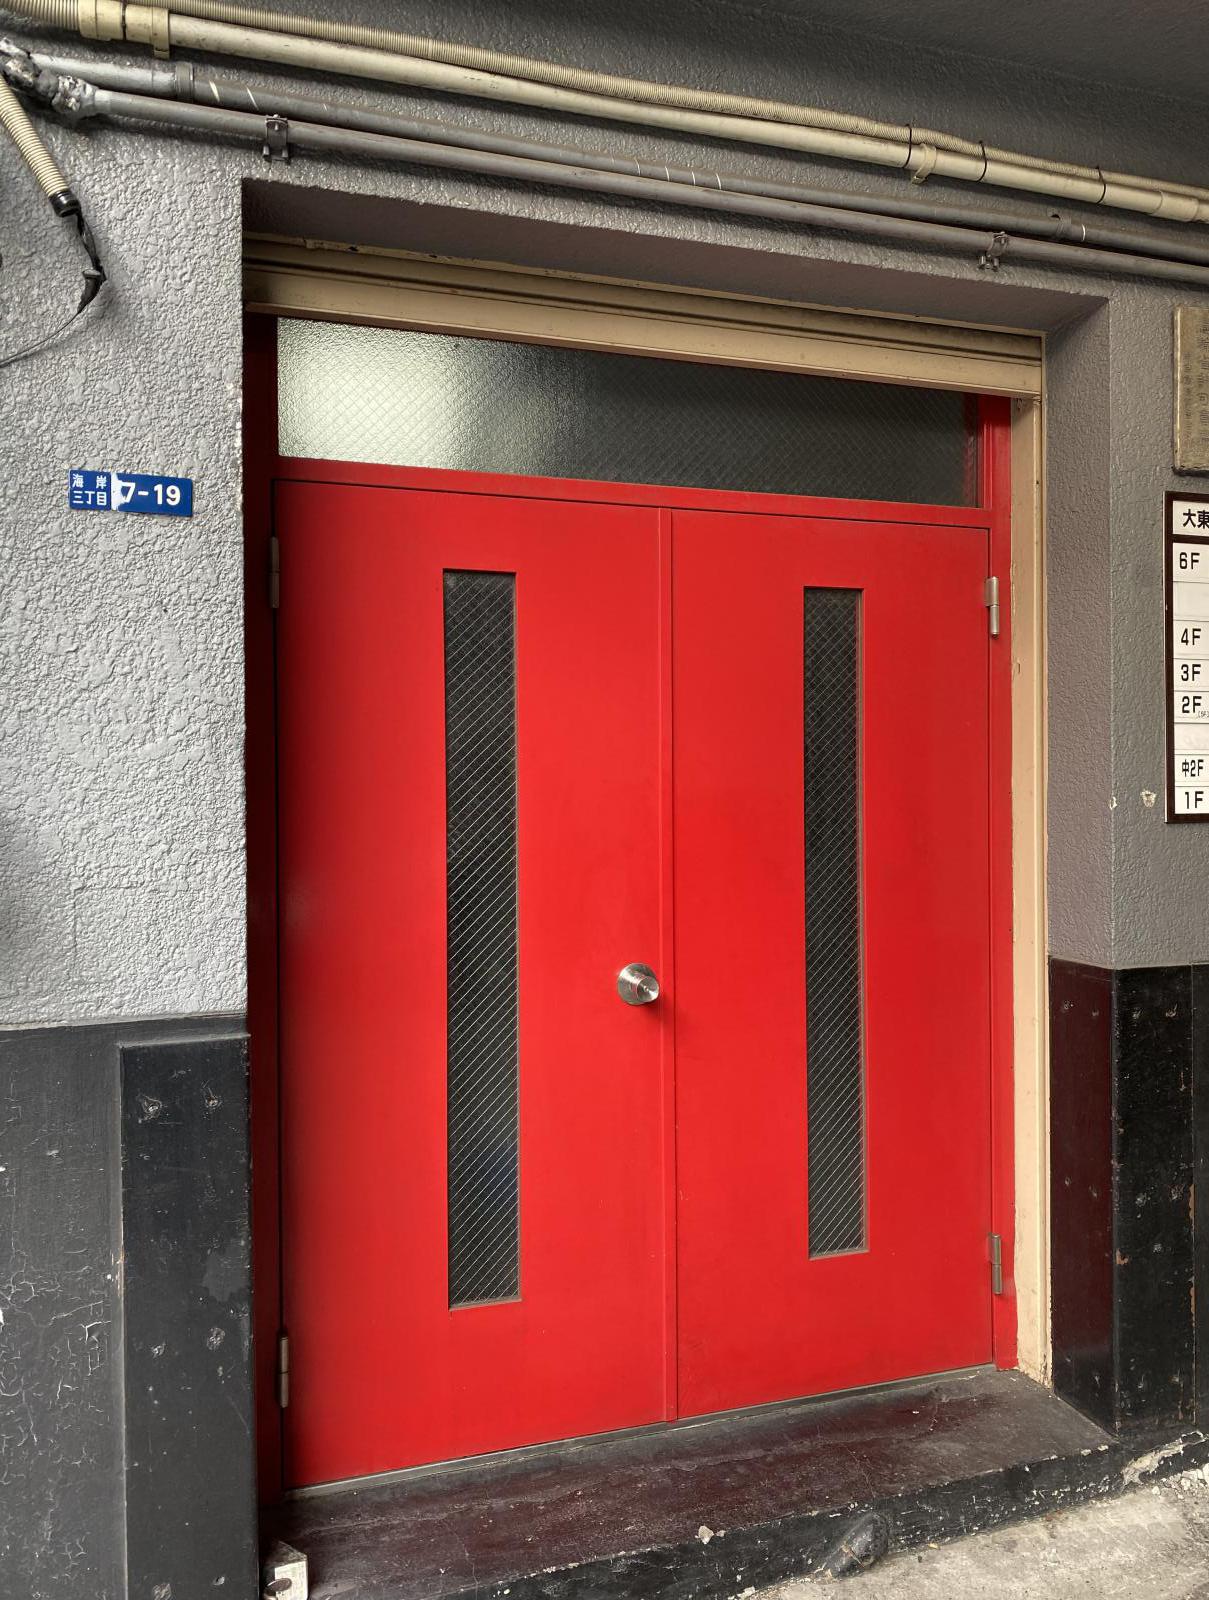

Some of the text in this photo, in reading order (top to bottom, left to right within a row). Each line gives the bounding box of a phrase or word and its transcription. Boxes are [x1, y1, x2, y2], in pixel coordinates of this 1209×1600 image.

[72, 490, 107, 506] 三丁目
[1179, 552, 1200, 569] 6F
[1181, 628, 1201, 645] 4F
[1180, 664, 1201, 681] 3F
[1182, 696, 1202, 713] 2F
[1182, 759, 1204, 777] 中2F
[1185, 791, 1204, 809] 1F
